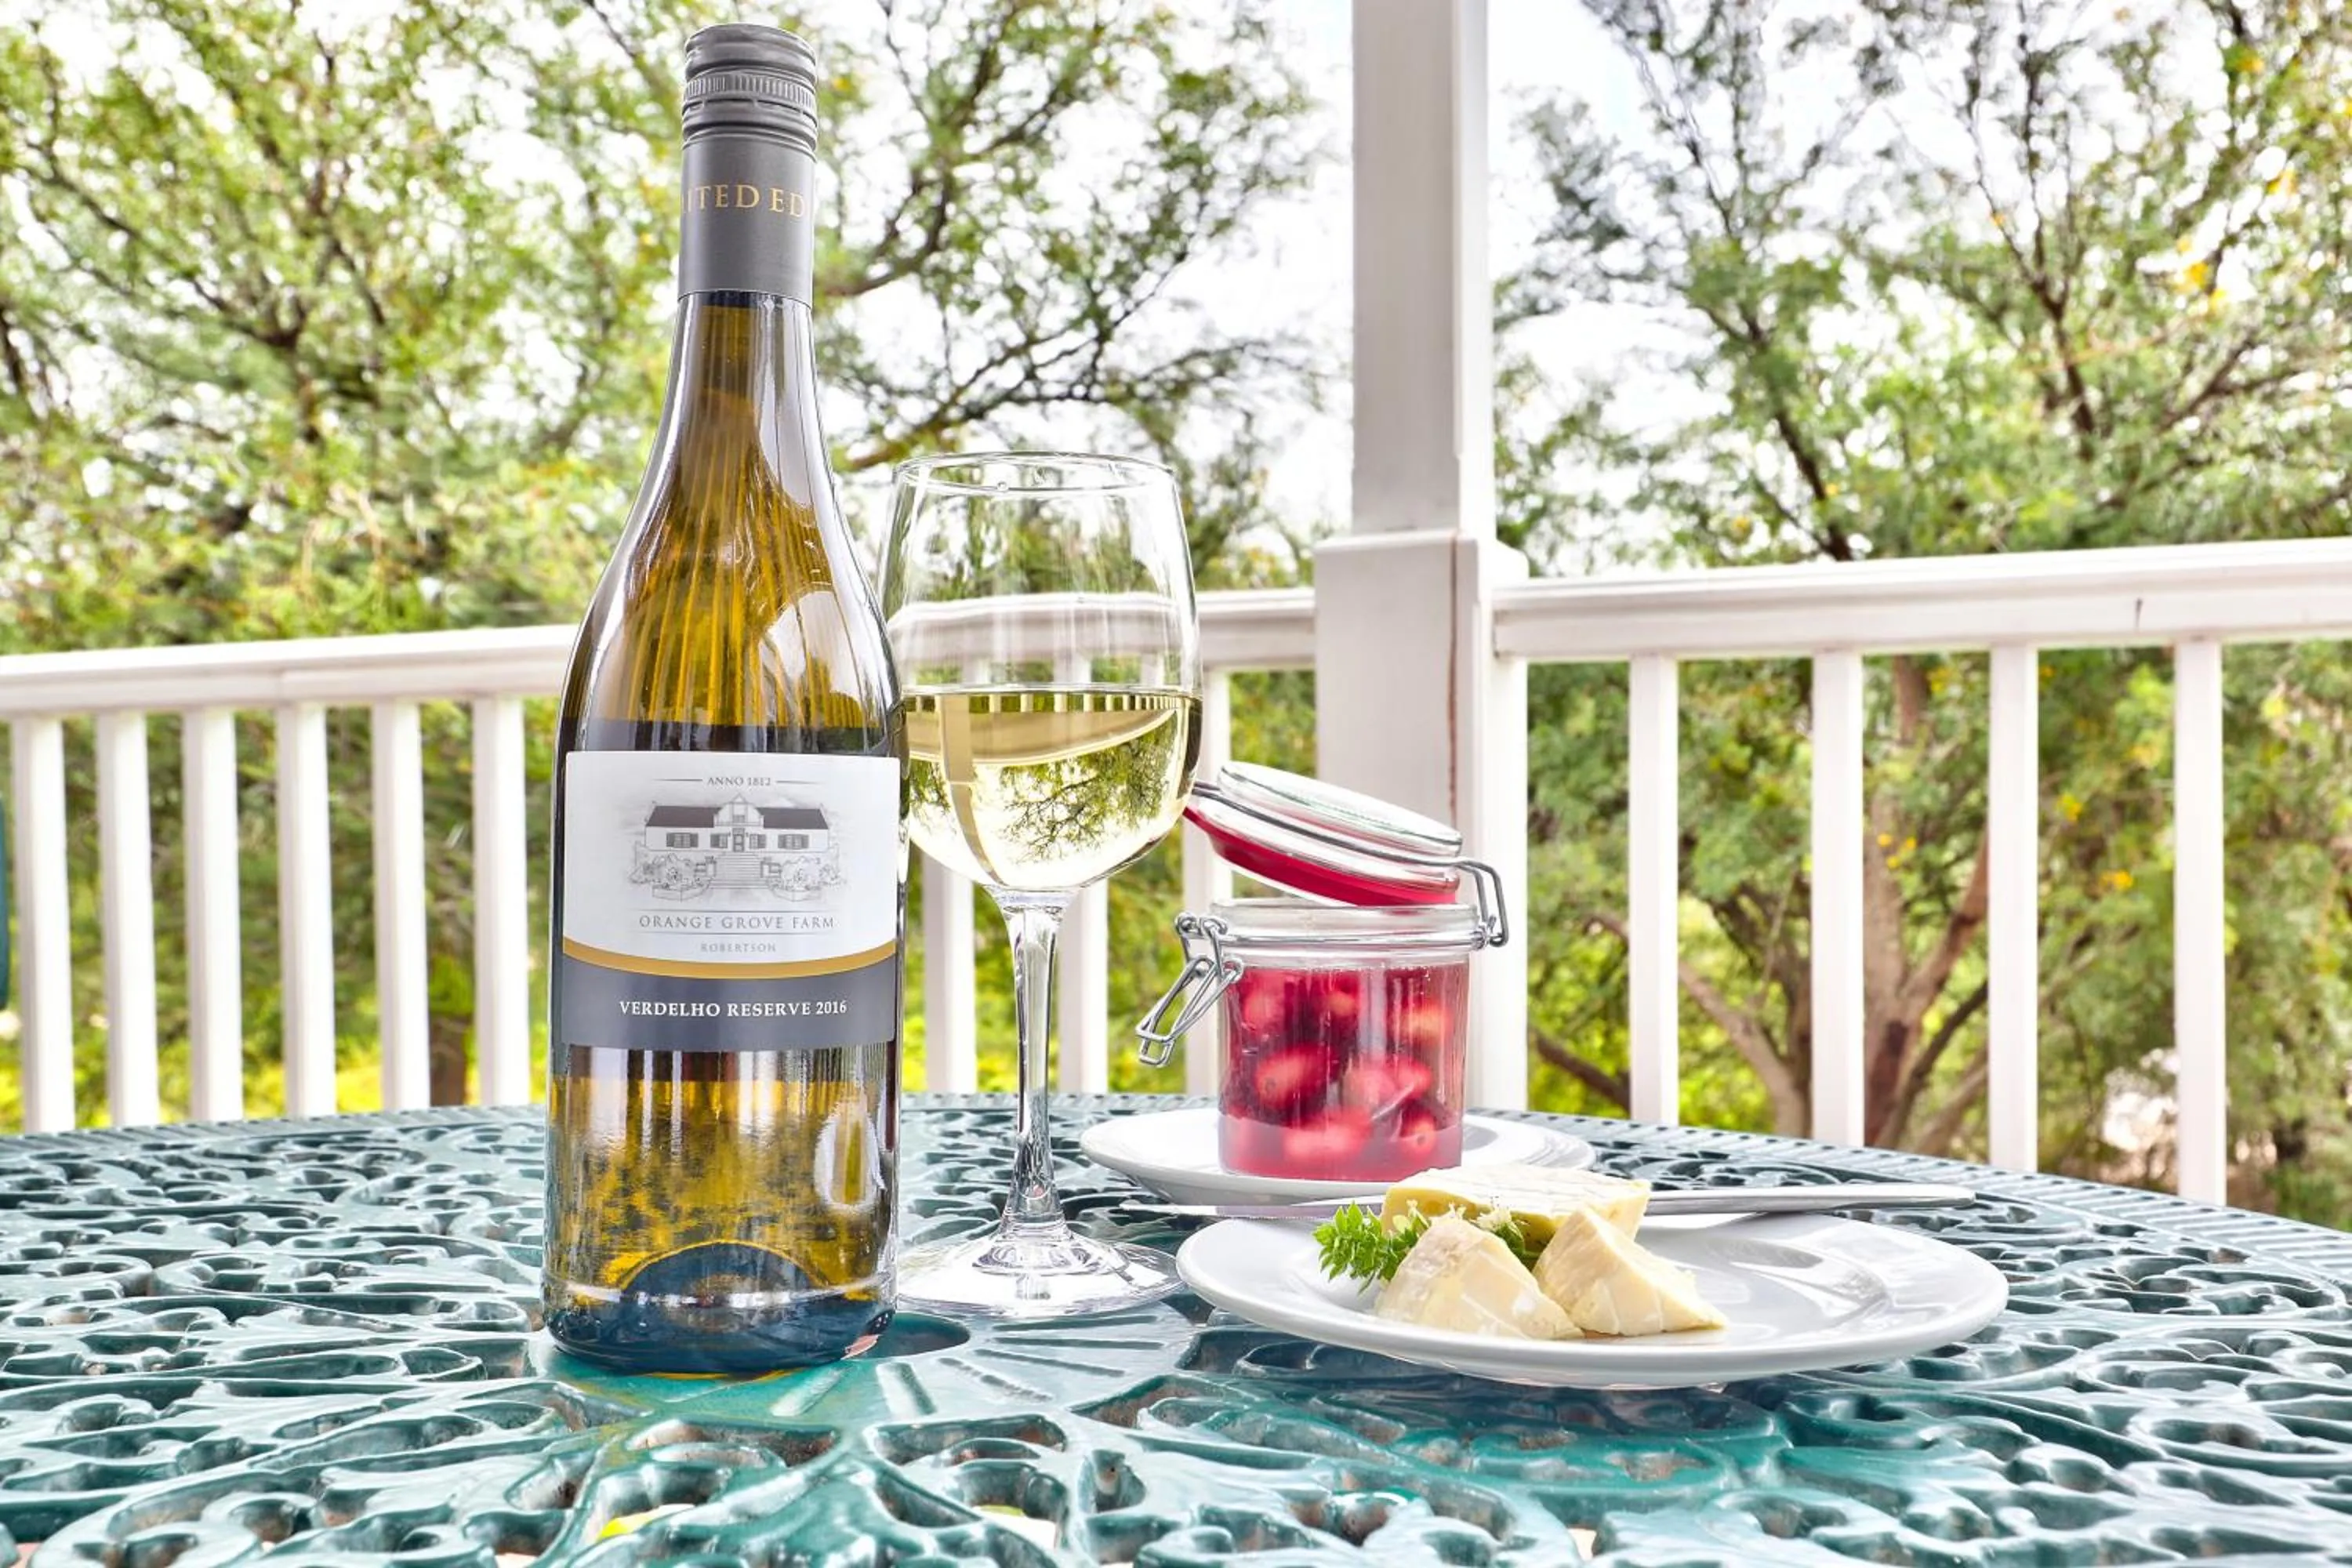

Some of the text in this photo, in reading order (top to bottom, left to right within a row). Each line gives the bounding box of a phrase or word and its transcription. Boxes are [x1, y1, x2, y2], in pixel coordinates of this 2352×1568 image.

[681, 184, 760, 214] ITED
[707, 777, 771, 786] ANNO 1812
[639, 915, 835, 930] ORANGE GROVE FARM
[700, 942, 776, 953] ROBERTSON
[619, 1000, 848, 1017] VERDELHO RESERVE 2016
